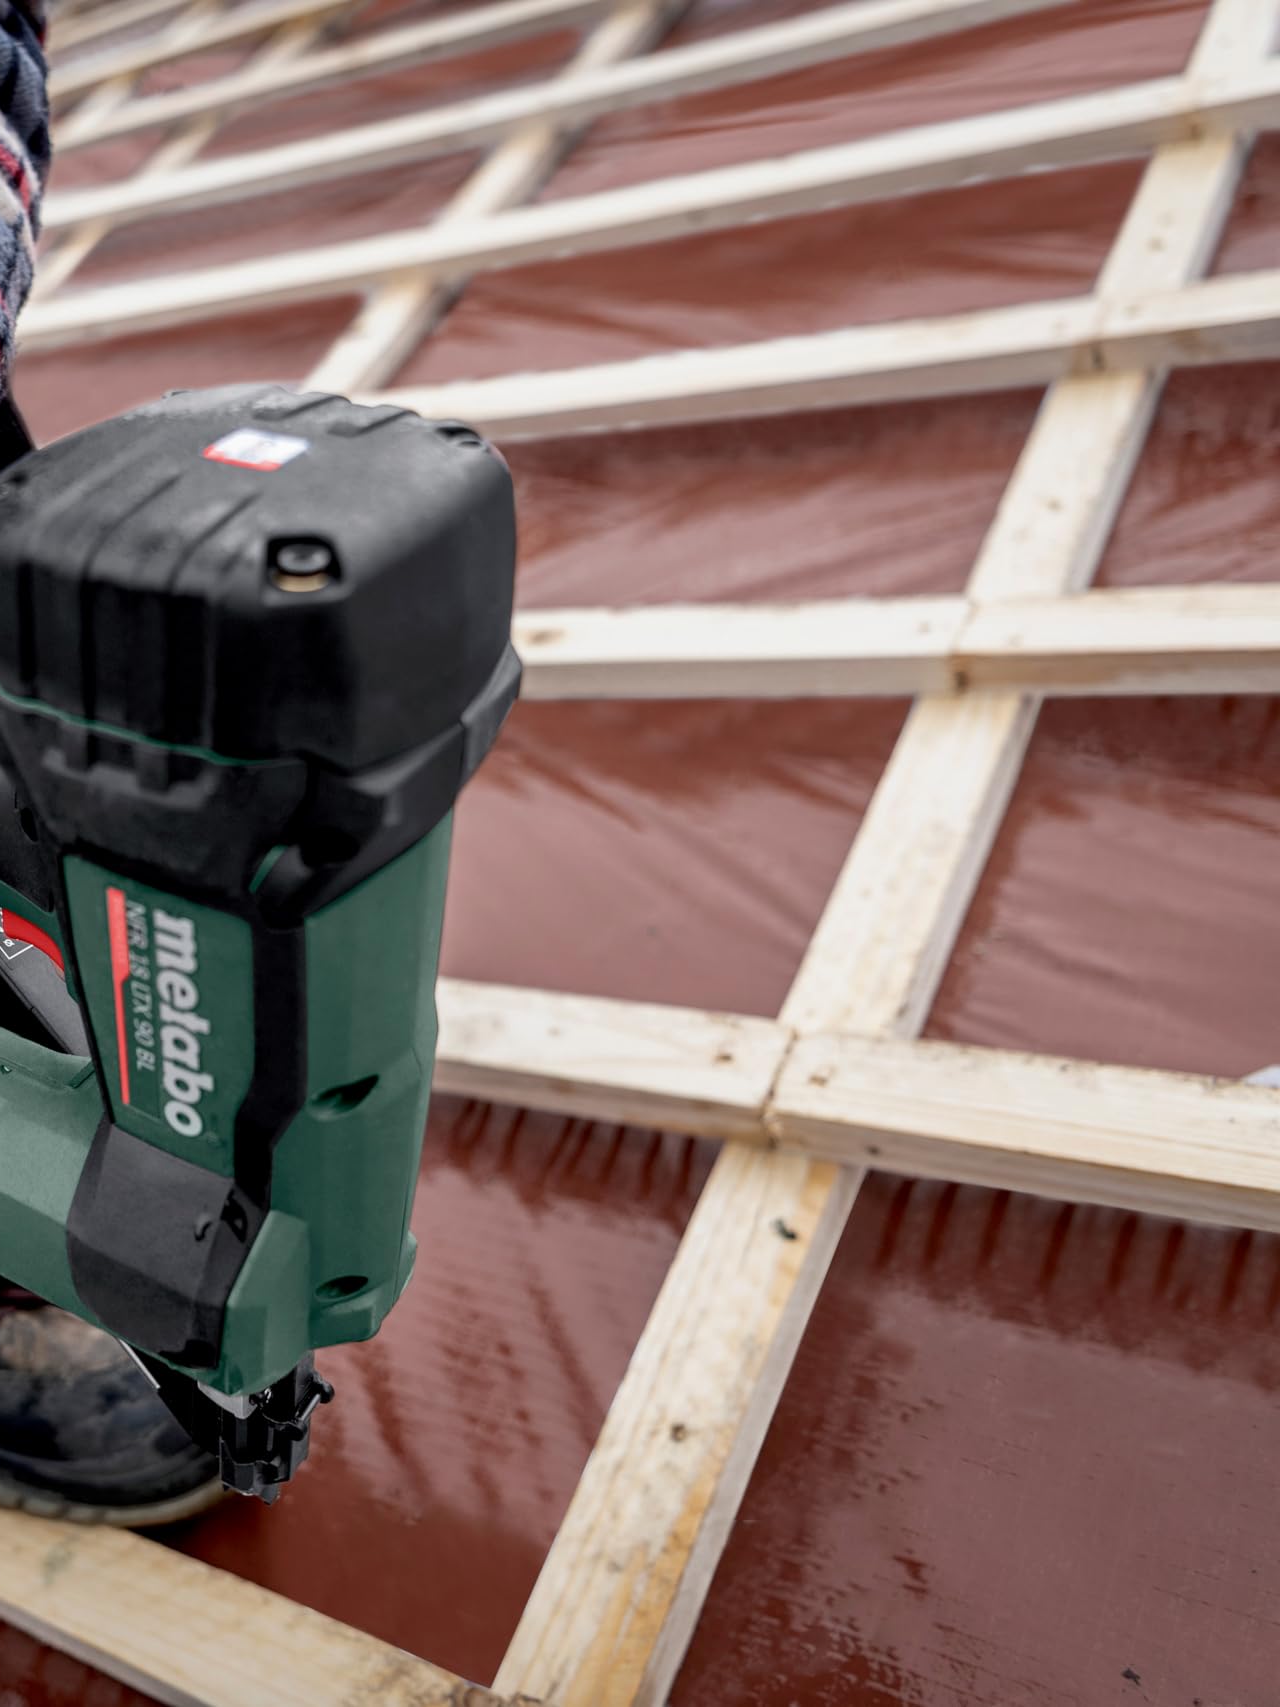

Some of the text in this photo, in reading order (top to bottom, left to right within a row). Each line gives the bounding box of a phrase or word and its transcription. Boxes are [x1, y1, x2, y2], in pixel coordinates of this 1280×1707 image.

[130, 980, 153, 1019] LTX
[134, 1018, 155, 1048] 90
[153, 909, 214, 1137] metabo
[136, 1048, 156, 1072] BL
